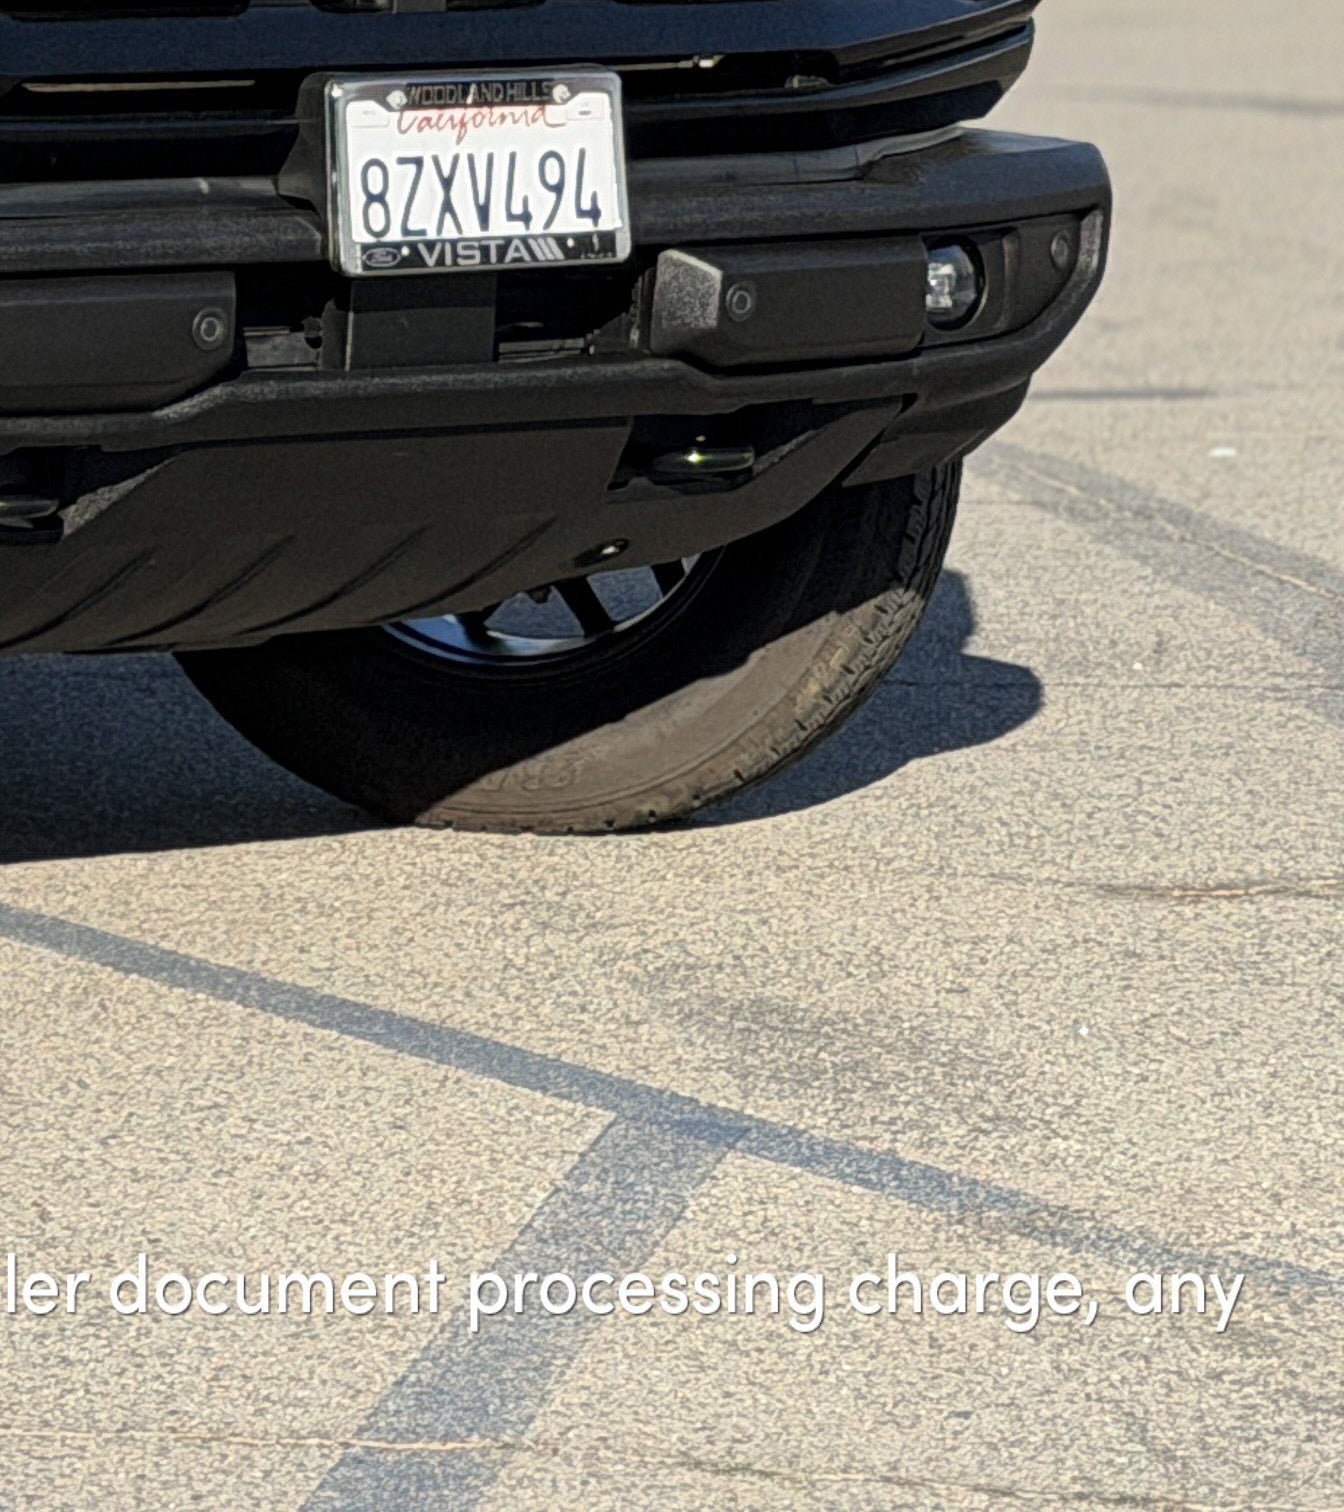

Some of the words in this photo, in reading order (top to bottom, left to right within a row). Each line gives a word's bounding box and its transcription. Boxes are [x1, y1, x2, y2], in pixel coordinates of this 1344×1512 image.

[408, 83, 505, 105] WOODLAND
[506, 81, 551, 101] HILLS
[397, 105, 566, 146] California
[361, 147, 602, 238] 8ZXV494
[417, 238, 533, 268] VISTA
